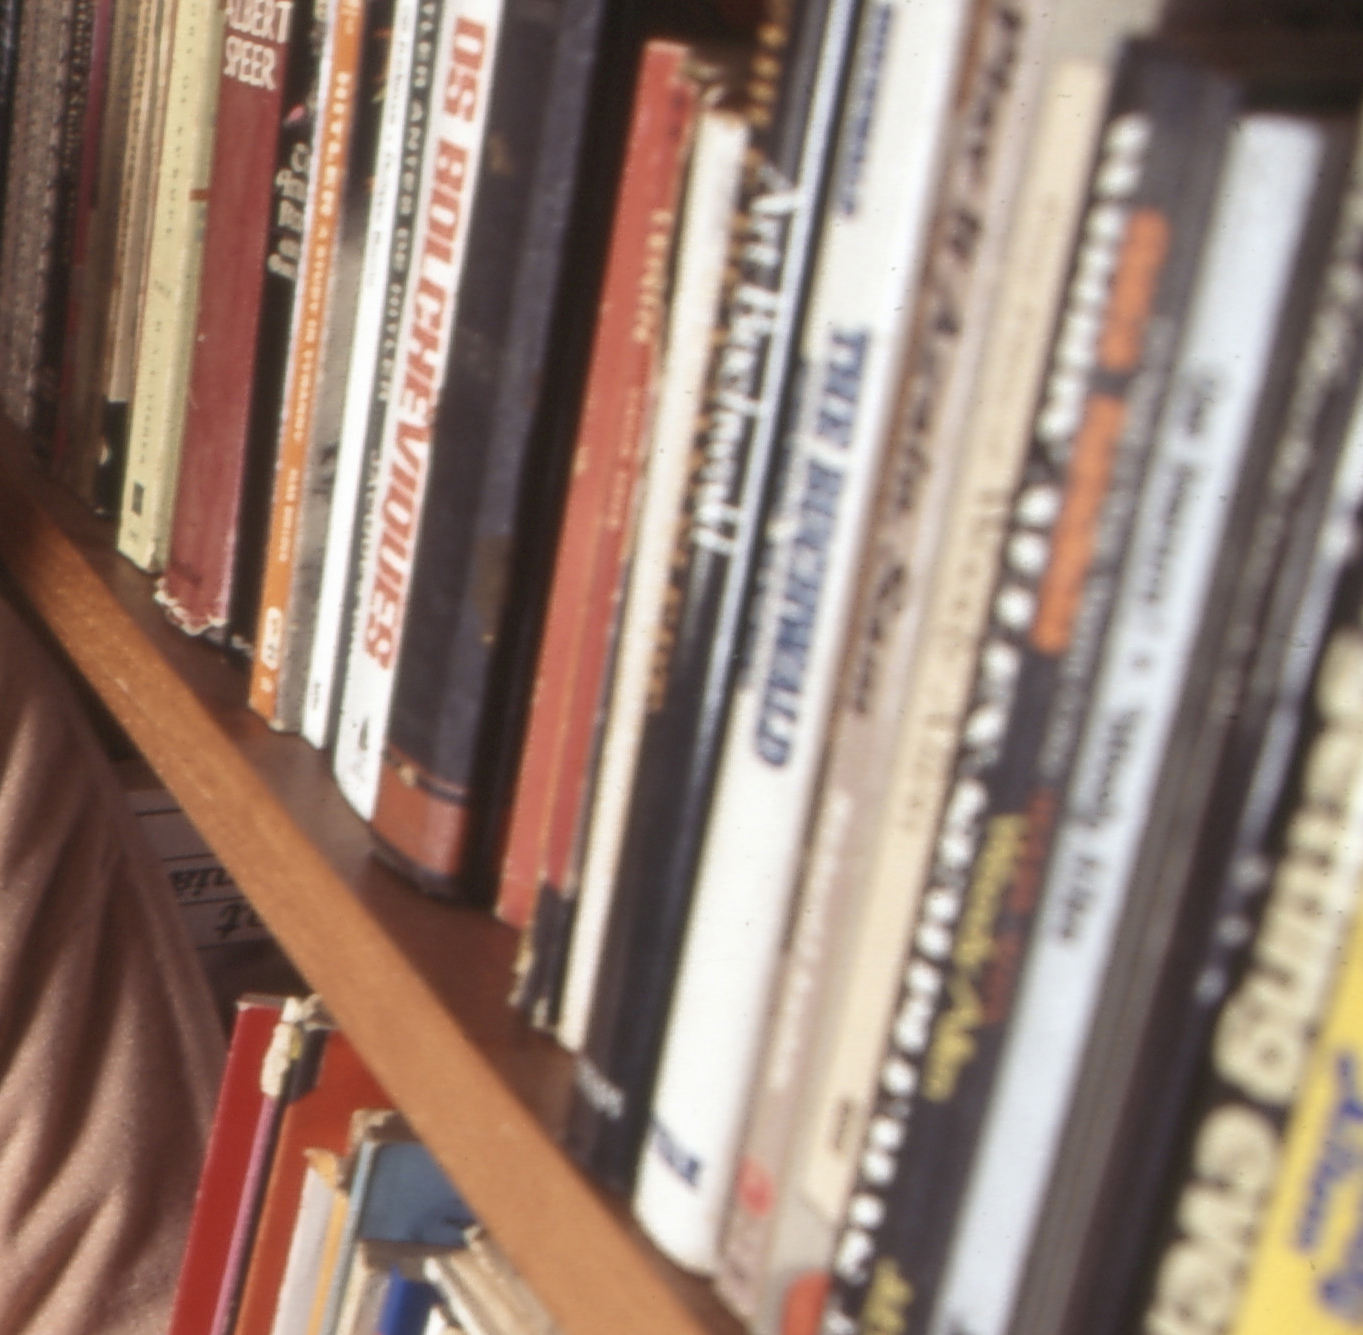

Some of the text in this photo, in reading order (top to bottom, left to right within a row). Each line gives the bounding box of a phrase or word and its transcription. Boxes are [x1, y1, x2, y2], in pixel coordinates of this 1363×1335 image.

[413, 0, 436, 87] TLER
[444, 17, 486, 123] OS
[318, 71, 351, 216] HITLER
[392, 226, 411, 273] DE
[366, 139, 470, 668] BOLCHEVIQUES
[379, 284, 405, 402] HITLER
[689, 159, 802, 559] Art Buchwald
[815, 328, 869, 449] THE
[754, 461, 846, 770] BUCHWALD
